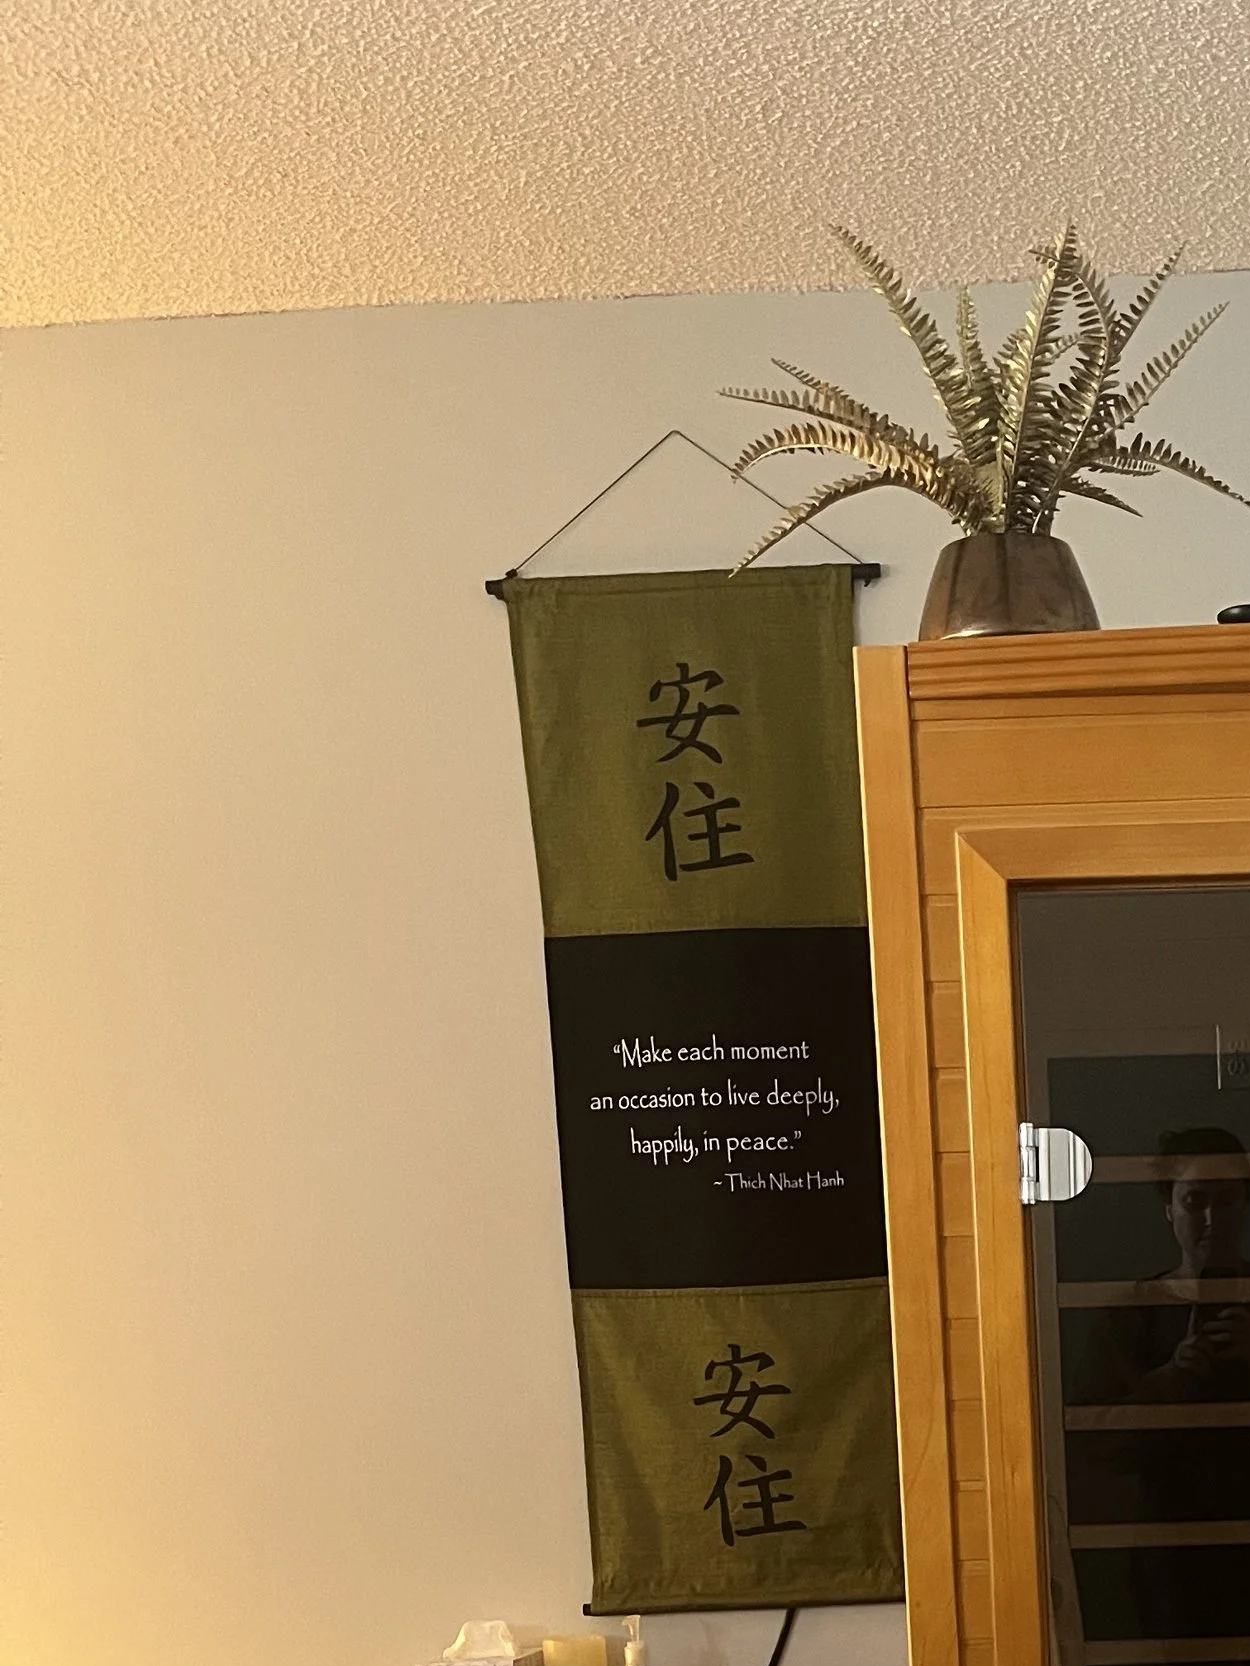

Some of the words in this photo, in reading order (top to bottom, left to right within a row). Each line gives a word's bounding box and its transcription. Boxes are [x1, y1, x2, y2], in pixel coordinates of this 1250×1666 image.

[636, 662, 755, 882] 安住
[612, 1035, 674, 1069] “Make
[677, 1033, 726, 1063] each
[730, 1040, 811, 1061] moment
[589, 1095, 614, 1111] an
[618, 1086, 696, 1110] occasion
[700, 1087, 723, 1107] to
[726, 1078, 761, 1107] live
[766, 1076, 841, 1117] deeply,
[630, 1125, 700, 1166] happily,
[703, 1130, 721, 1152] in
[726, 1130, 803, 1164] peace.”
[769, 1172, 805, 1192] Nhat
[806, 1170, 845, 1190] Hanh
[692, 1342, 808, 1548] 安住
